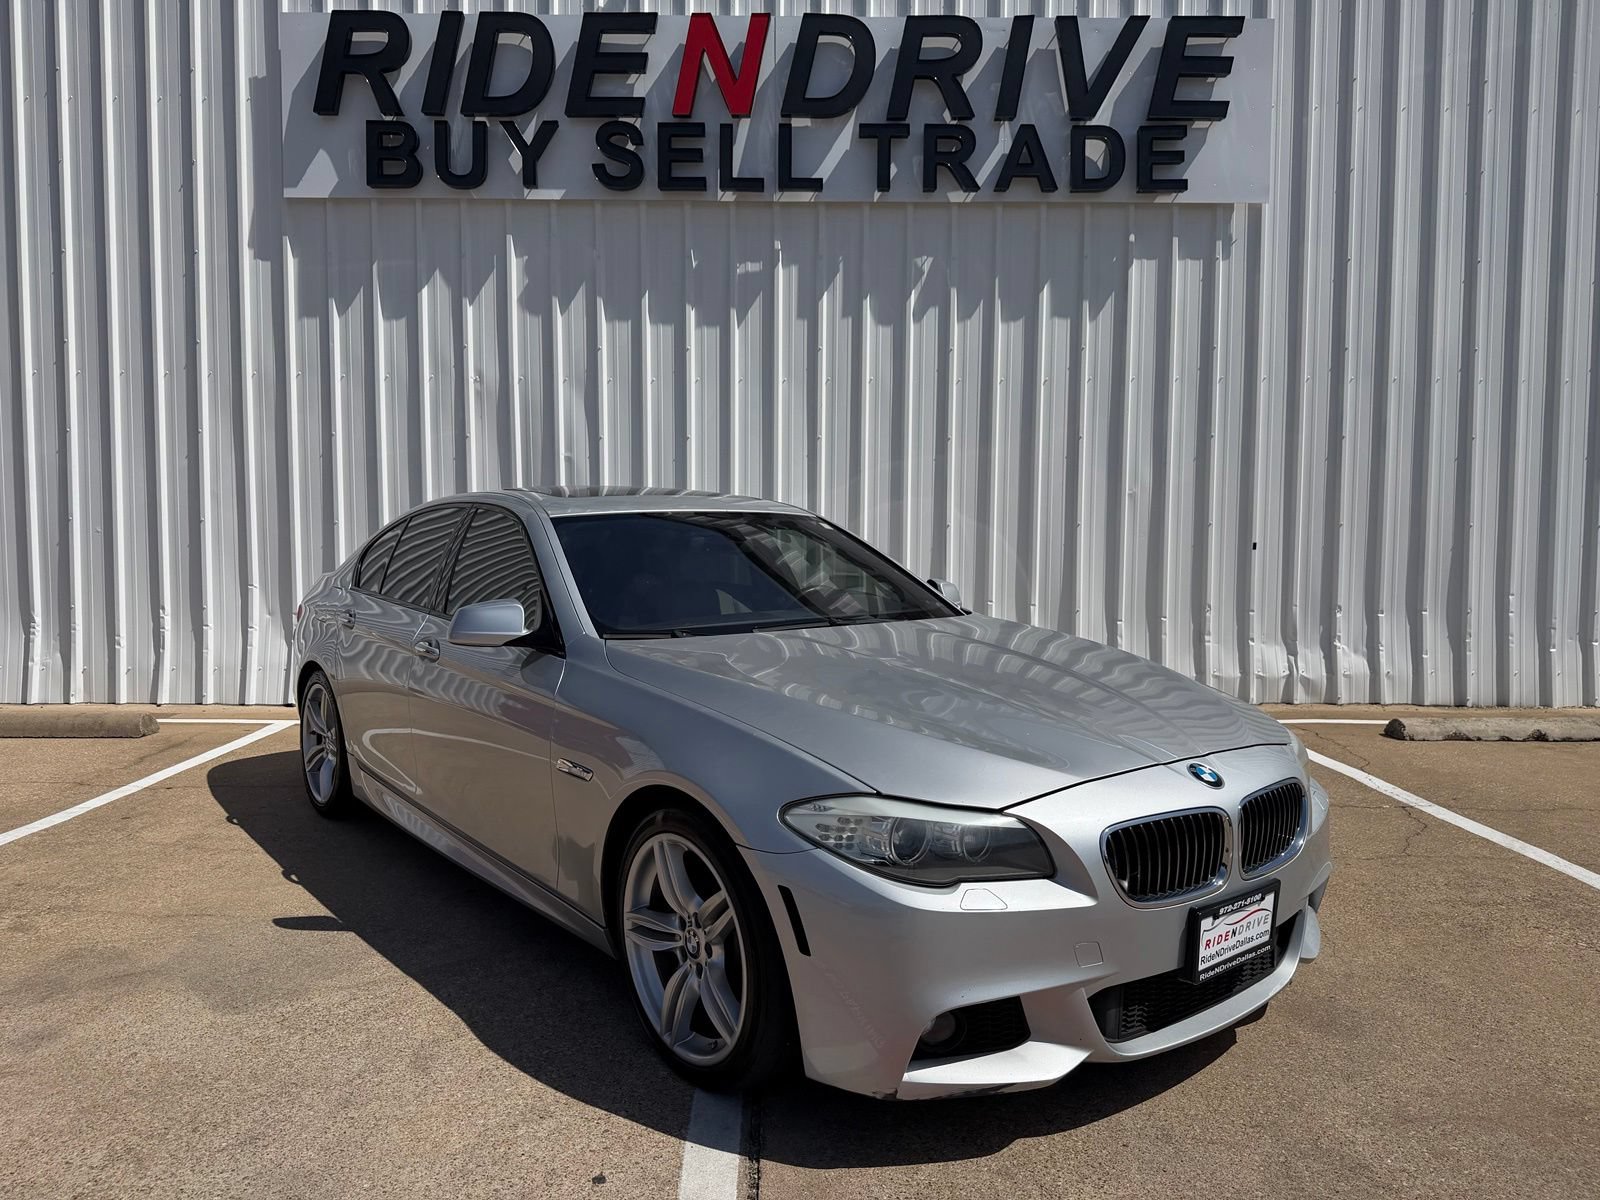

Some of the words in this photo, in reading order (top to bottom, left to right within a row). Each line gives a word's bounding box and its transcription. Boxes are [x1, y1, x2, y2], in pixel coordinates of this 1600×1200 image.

[313, 10, 1245, 121] RIDENDRIVE
[366, 119, 558, 190] BUY
[592, 121, 824, 192] SELL
[859, 123, 1188, 193] TRADE
[1200, 929, 1270, 966] RideNDriveDallas.com
[1204, 913, 1270, 950] RIDENDRIVE
[1200, 944, 1271, 981] RideNDriveDallas.com
